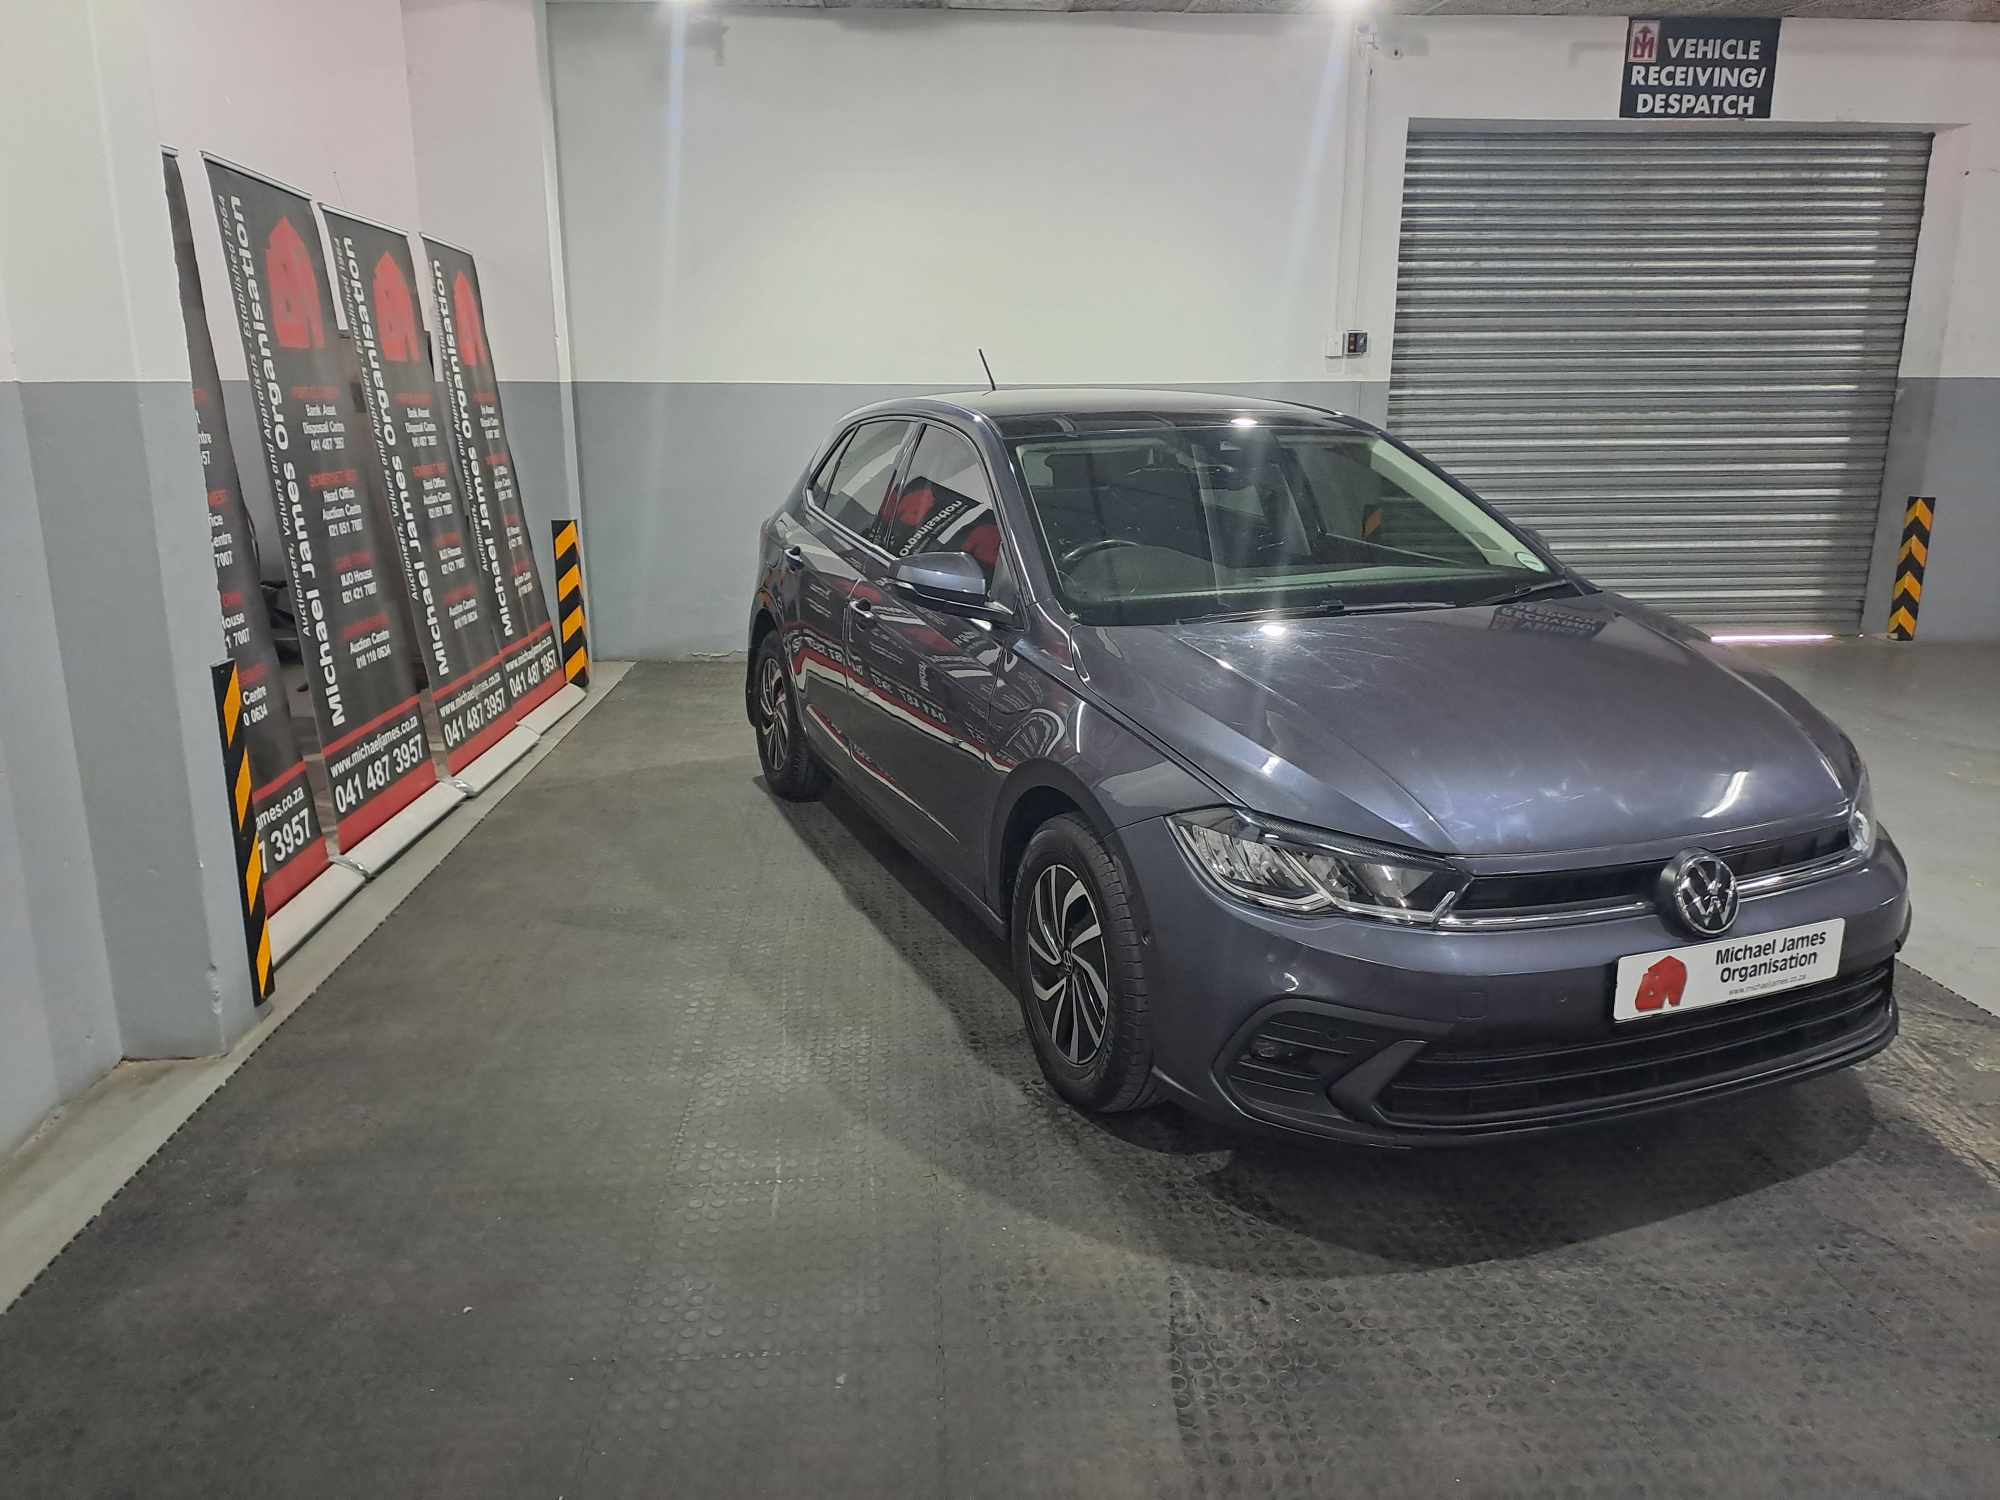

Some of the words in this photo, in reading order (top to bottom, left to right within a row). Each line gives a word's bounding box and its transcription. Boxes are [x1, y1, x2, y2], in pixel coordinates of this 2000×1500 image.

[1630, 65, 1766, 89] RECEIVING/
[1667, 38, 1761, 60] VEHICLE
[1636, 93, 1755, 115] DESPATCH
[231, 195, 289, 450] Organisation
[343, 237, 396, 446] Organisation
[434, 260, 472, 438] Organisation
[250, 353, 272, 439] Appraisers
[266, 442, 279, 474] and
[376, 439, 389, 466] and
[274, 479, 291, 536] Valuers
[391, 455, 421, 553] James
[468, 446, 491, 531] James
[283, 462, 316, 579] James
[484, 538, 514, 637] Michael
[414, 561, 450, 676] Michael
[306, 588, 346, 727] Michael
[509, 672, 527, 698] 041
[527, 661, 540, 686] 487
[540, 649, 558, 676] 3957
[242, 685, 267, 706] Centre
[444, 715, 466, 747] 041
[466, 702, 485, 732] 487
[483, 687, 507, 720] 3957
[330, 715, 418, 778] www.michaeljames.co.za
[335, 772, 364, 813] 041
[366, 754, 390, 791] 487
[392, 733, 423, 773] 3957
[270, 807, 311, 862] 3957
[1715, 939, 1777, 965] Michael
[1779, 931, 1827, 954] James
[1719, 951, 1818, 983] Organisation
